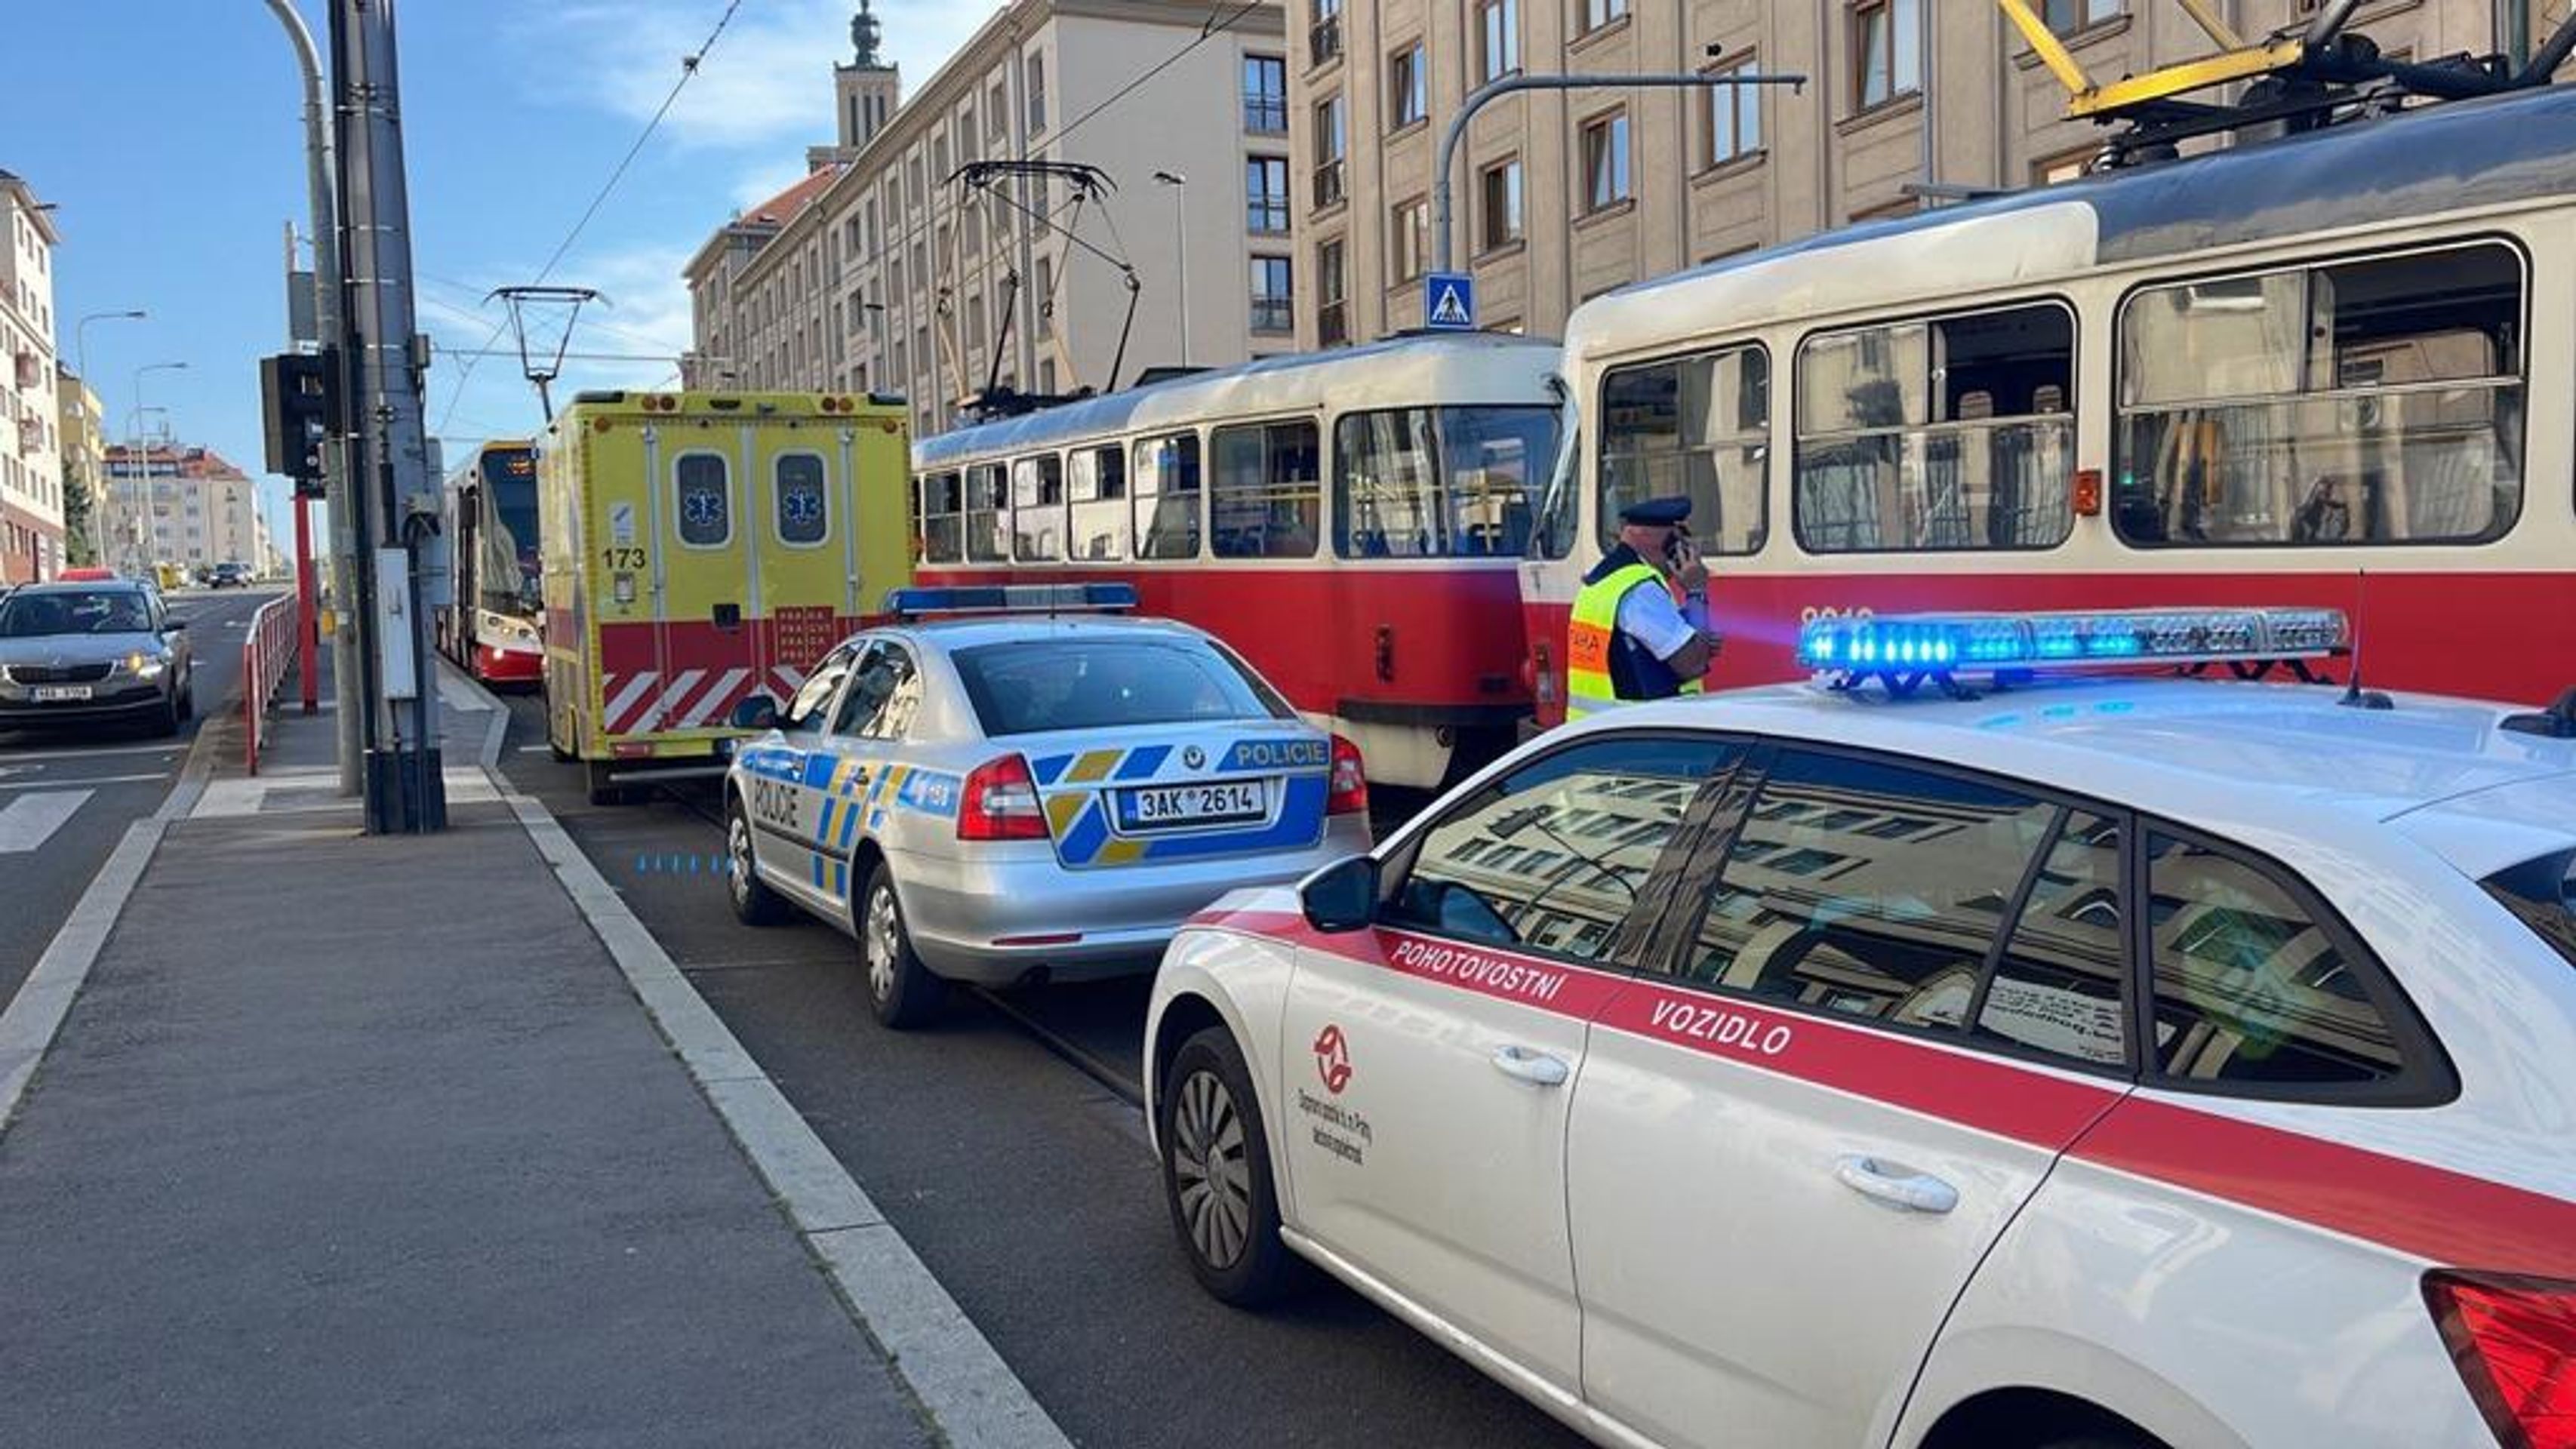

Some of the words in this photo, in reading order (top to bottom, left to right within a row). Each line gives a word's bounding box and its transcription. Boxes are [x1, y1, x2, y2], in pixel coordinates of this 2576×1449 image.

[603, 548, 646, 569] 173
[1236, 743, 1327, 767] POLICIE
[755, 777, 798, 829] POLICIE
[1142, 792, 1183, 817] 3AK
[1201, 787, 1252, 812] 2614
[1391, 940, 1568, 1001] POHOTOVOSTNÍ
[1651, 1000, 1791, 1054] VOZIDLO
